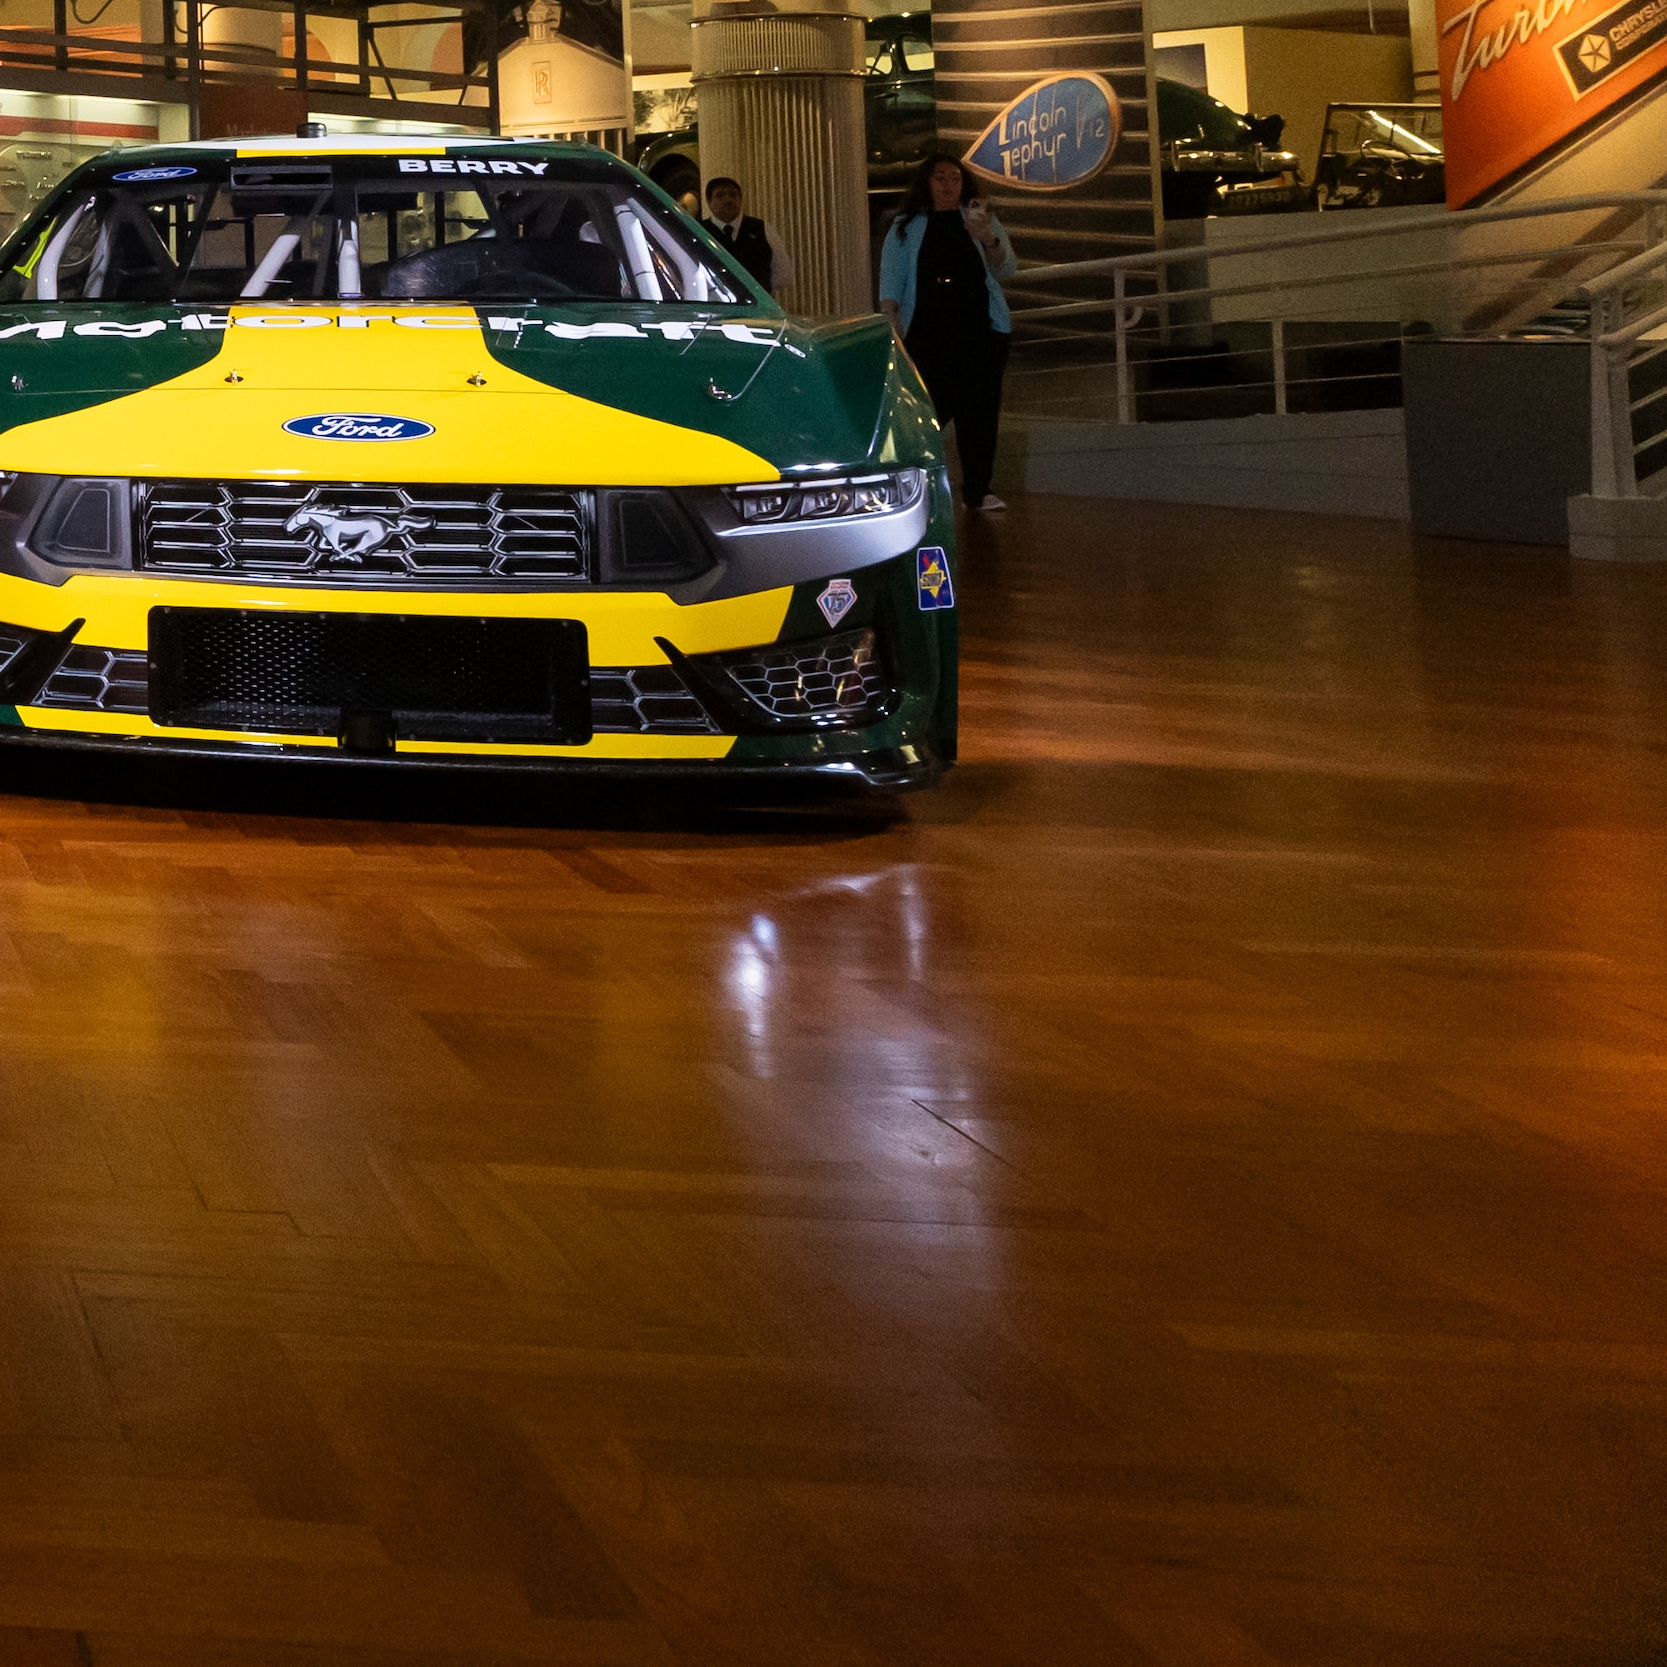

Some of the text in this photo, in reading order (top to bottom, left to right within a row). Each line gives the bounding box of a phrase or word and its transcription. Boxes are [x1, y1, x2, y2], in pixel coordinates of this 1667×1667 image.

[998, 89, 1067, 146] Lincoln
[1000, 110, 1067, 183] Zephyr
[128, 168, 182, 180] Ford
[398, 159, 549, 175] BERRY
[312, 416, 404, 437] Ford
